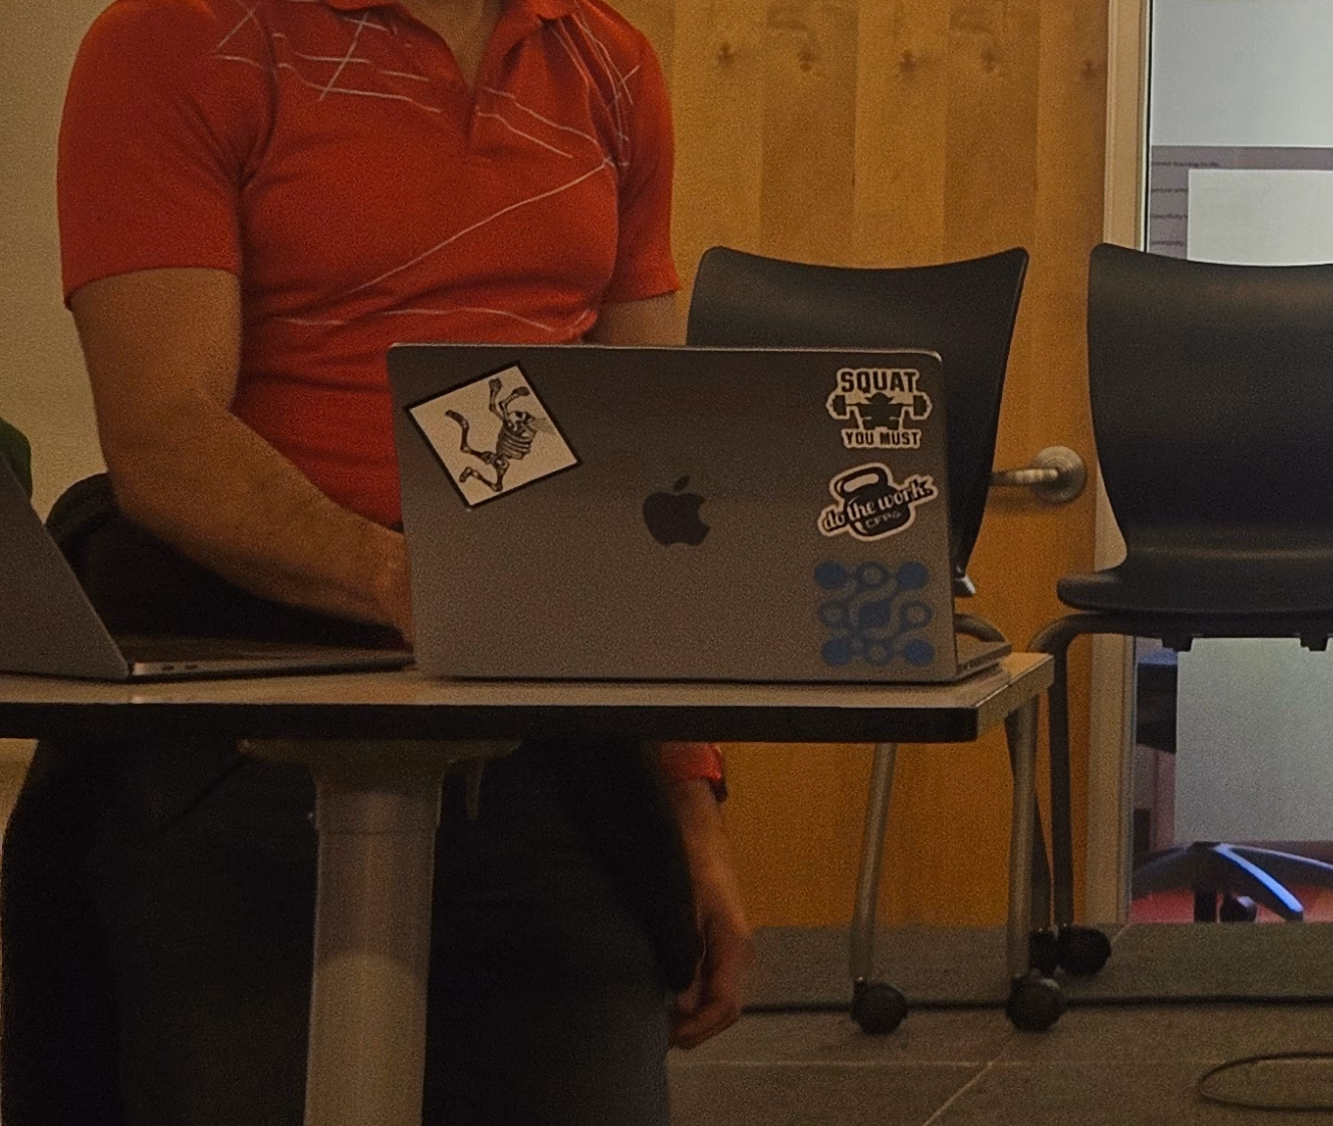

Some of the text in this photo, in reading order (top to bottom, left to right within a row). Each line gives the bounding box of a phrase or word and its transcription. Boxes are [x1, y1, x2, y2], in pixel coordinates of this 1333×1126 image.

[840, 371, 917, 393] SQUAT
[845, 431, 919, 445] YOU MUST
[824, 509, 845, 531] do
[847, 500, 876, 522] the
